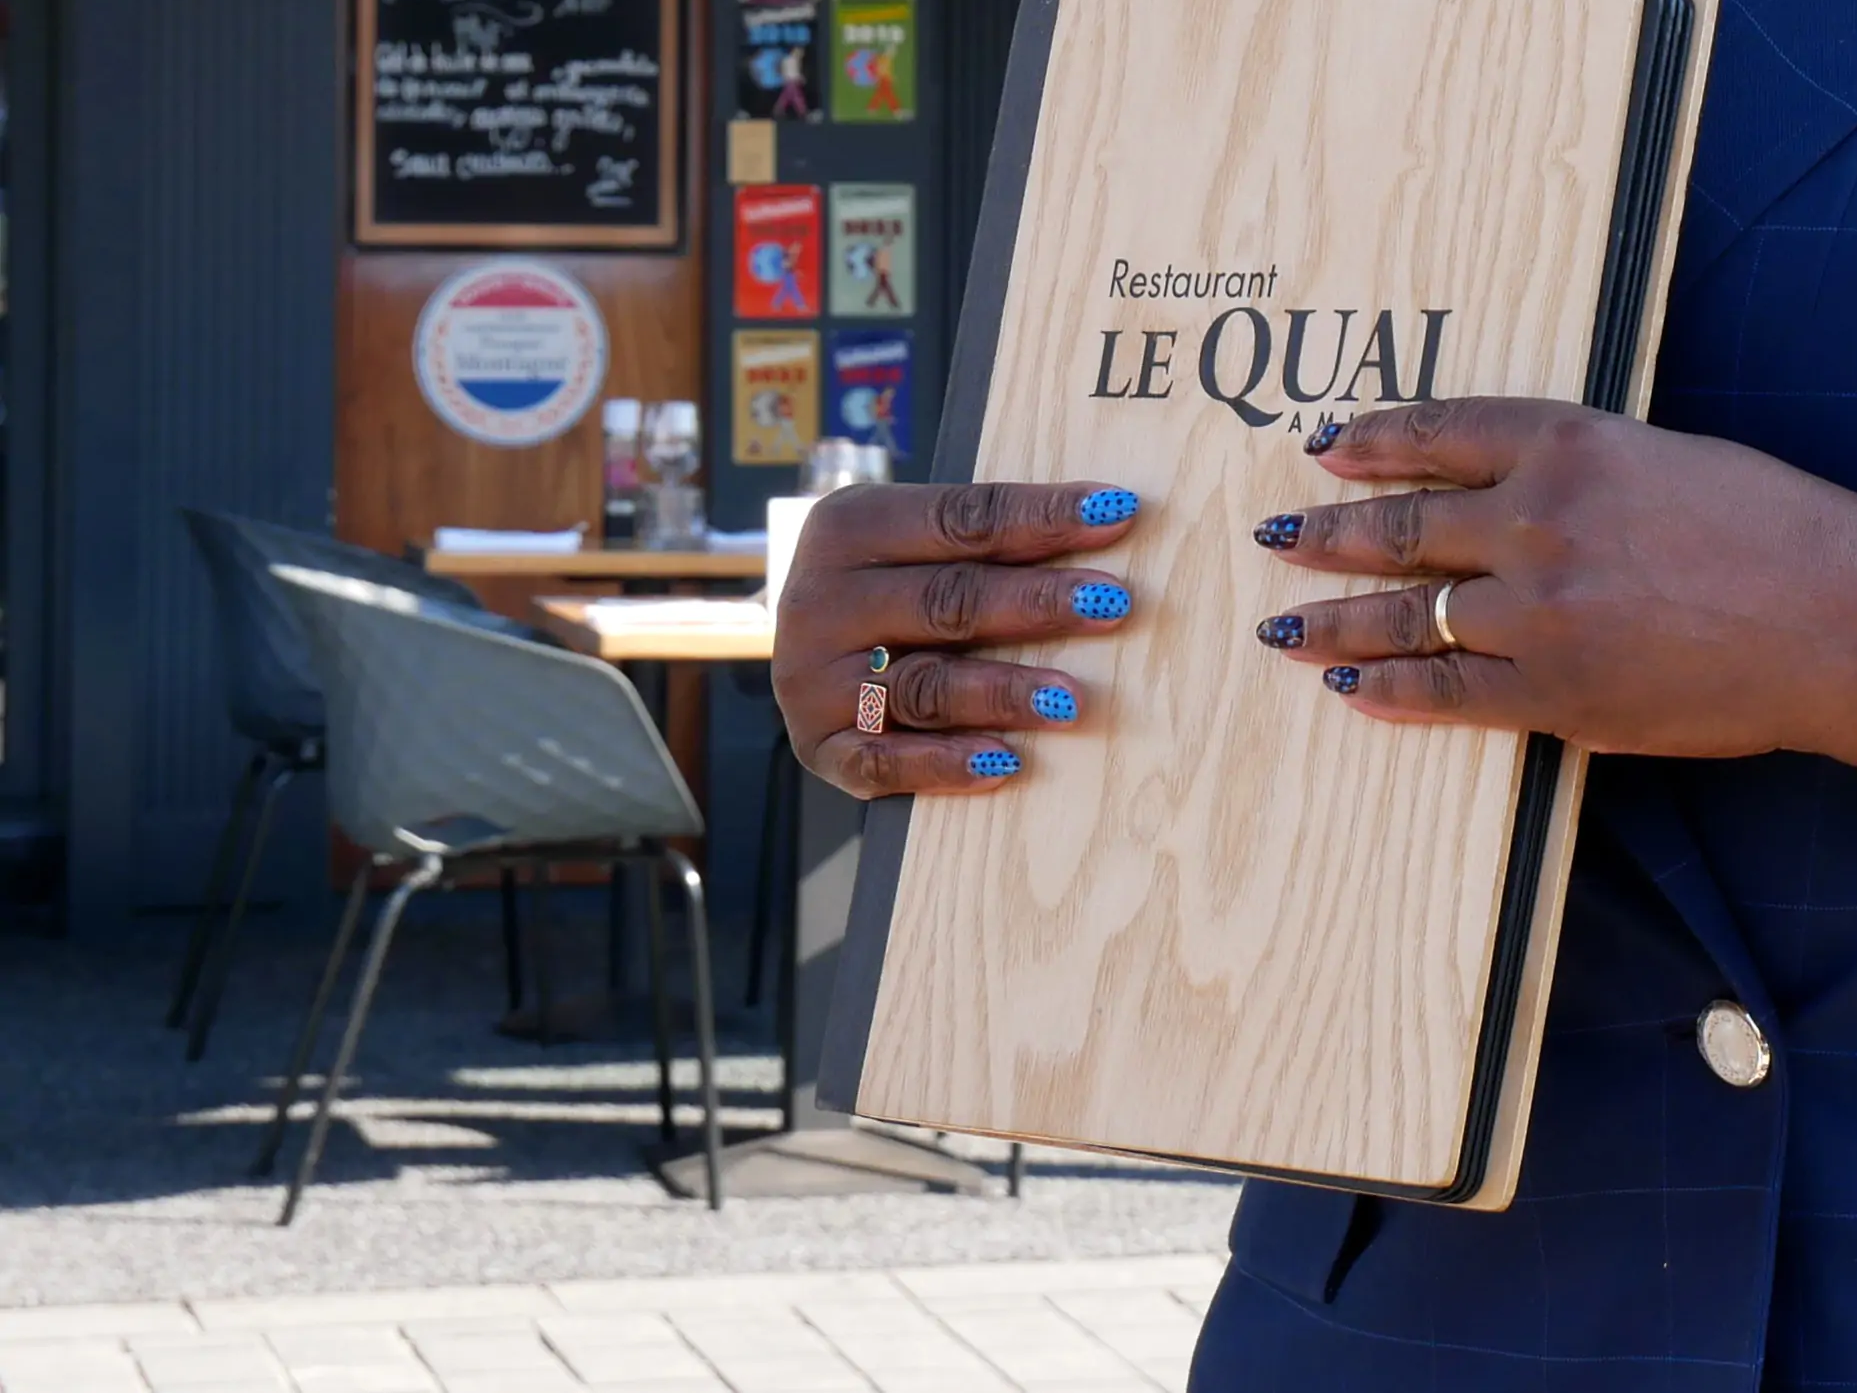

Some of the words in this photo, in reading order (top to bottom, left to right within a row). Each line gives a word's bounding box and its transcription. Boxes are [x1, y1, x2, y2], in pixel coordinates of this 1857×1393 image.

[1108, 258, 1278, 299] Restaurant
[1088, 330, 1178, 400] LE
[1198, 306, 1453, 428] QUAI
[1287, 410, 1355, 434] AM
